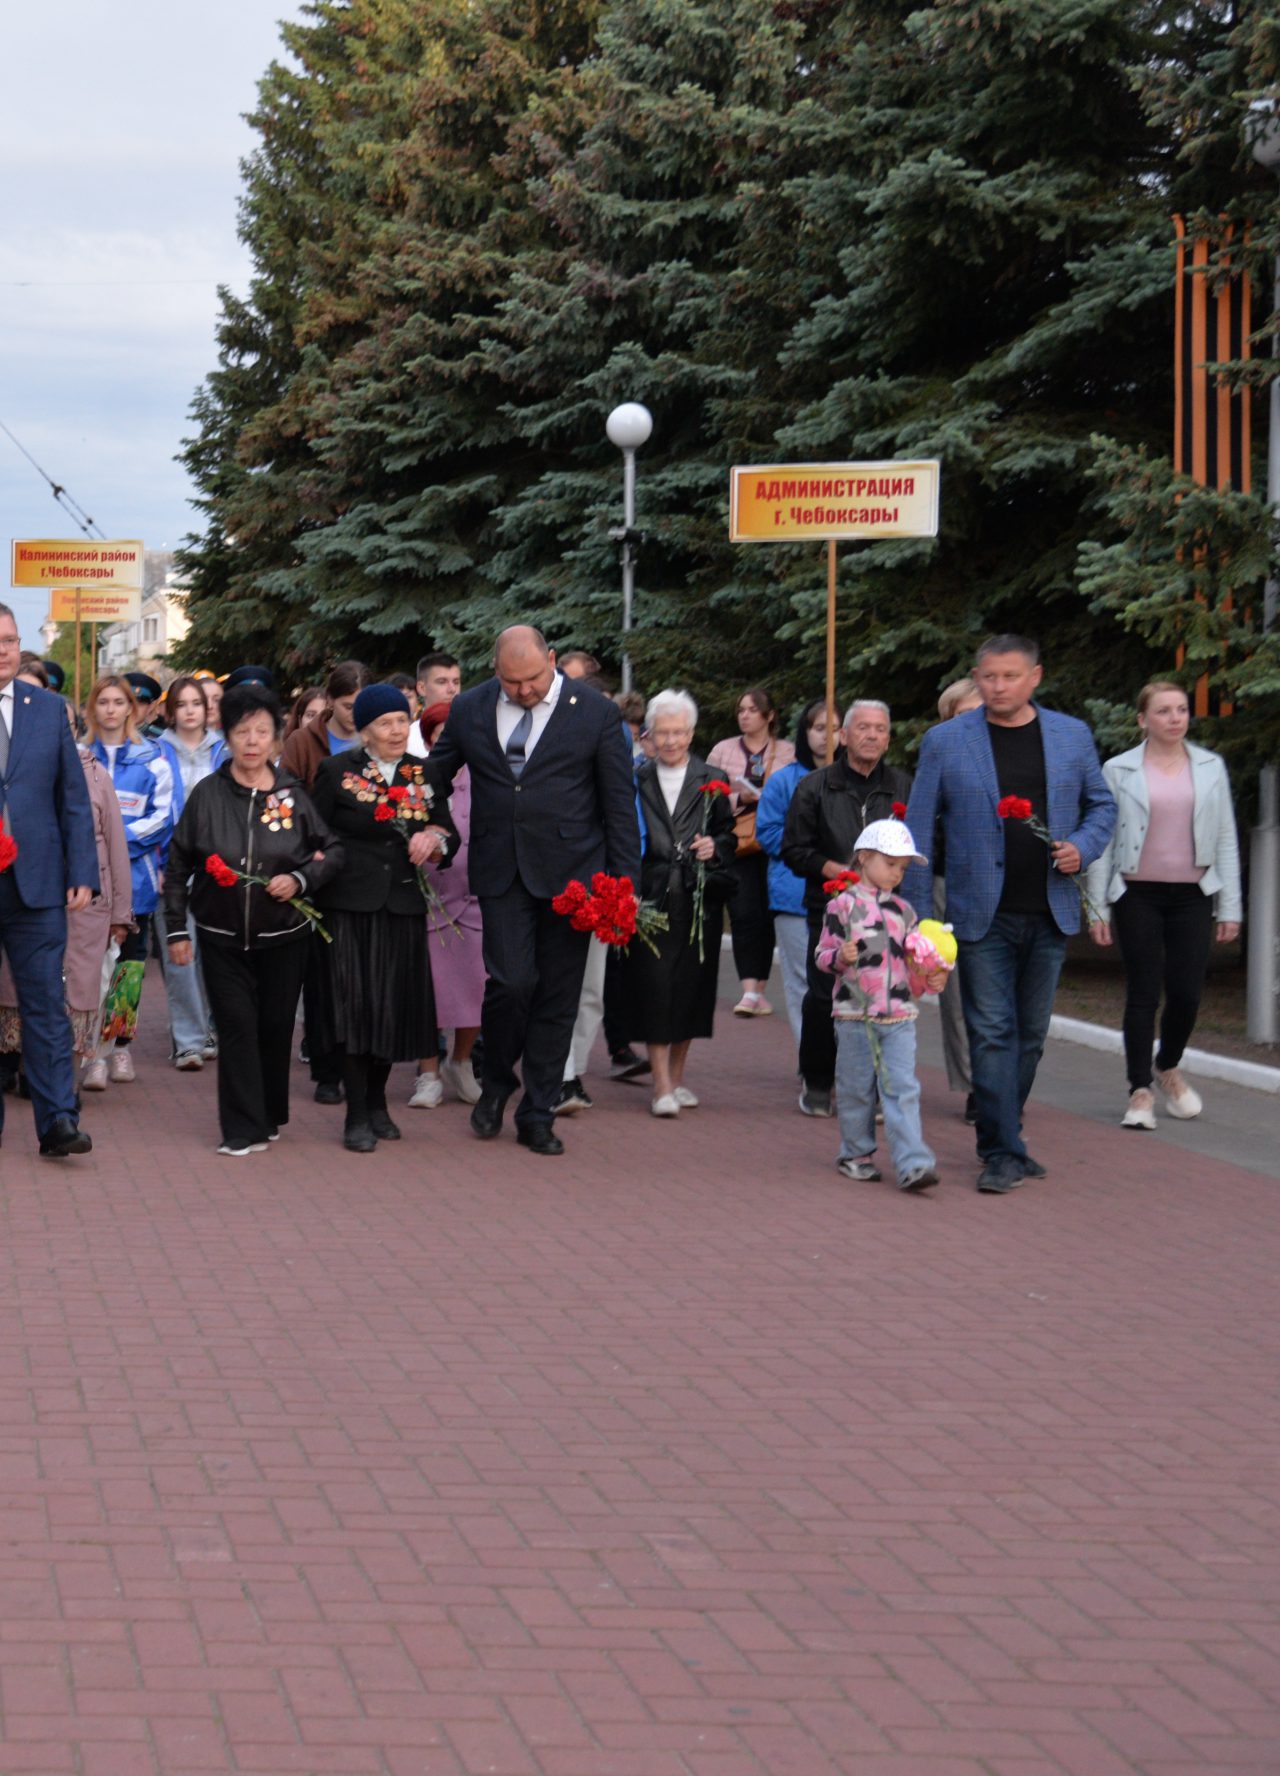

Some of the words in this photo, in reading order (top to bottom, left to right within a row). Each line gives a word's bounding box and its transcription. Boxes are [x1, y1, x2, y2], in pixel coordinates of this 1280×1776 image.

[755, 477, 915, 502] АДМИНИСТРАЦИЯ
[774, 510, 786, 525] г.
[790, 507, 899, 525] Чебоксары
[19, 549, 98, 562] Калининский
[101, 549, 136, 562] район
[40, 566, 114, 579] г.Чебоксары
[105, 595, 129, 605] район
